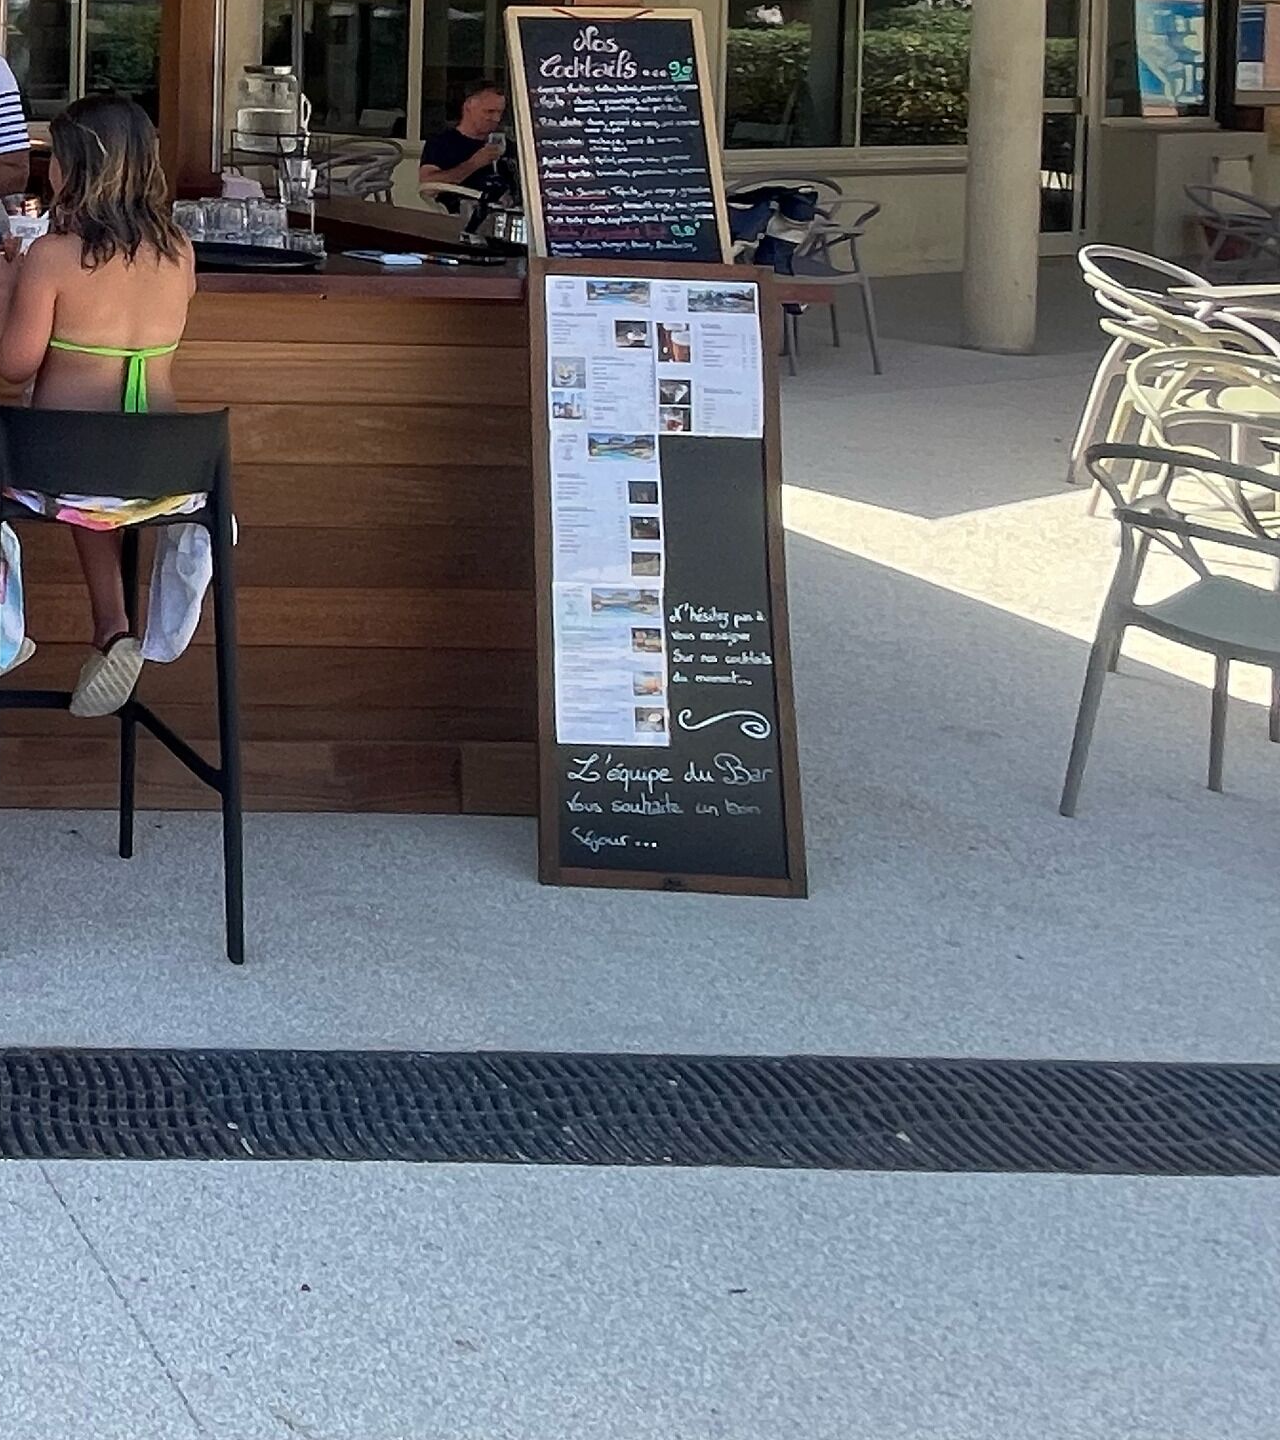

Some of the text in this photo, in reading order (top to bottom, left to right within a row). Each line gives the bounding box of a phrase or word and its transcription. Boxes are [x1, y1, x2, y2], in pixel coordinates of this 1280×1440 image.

[573, 25, 619, 53] Nos
[567, 752, 773, 793] L'équipe du Bar
[611, 792, 684, 816] souhaite
[696, 803, 720, 816] un
[724, 798, 761, 815] bon
